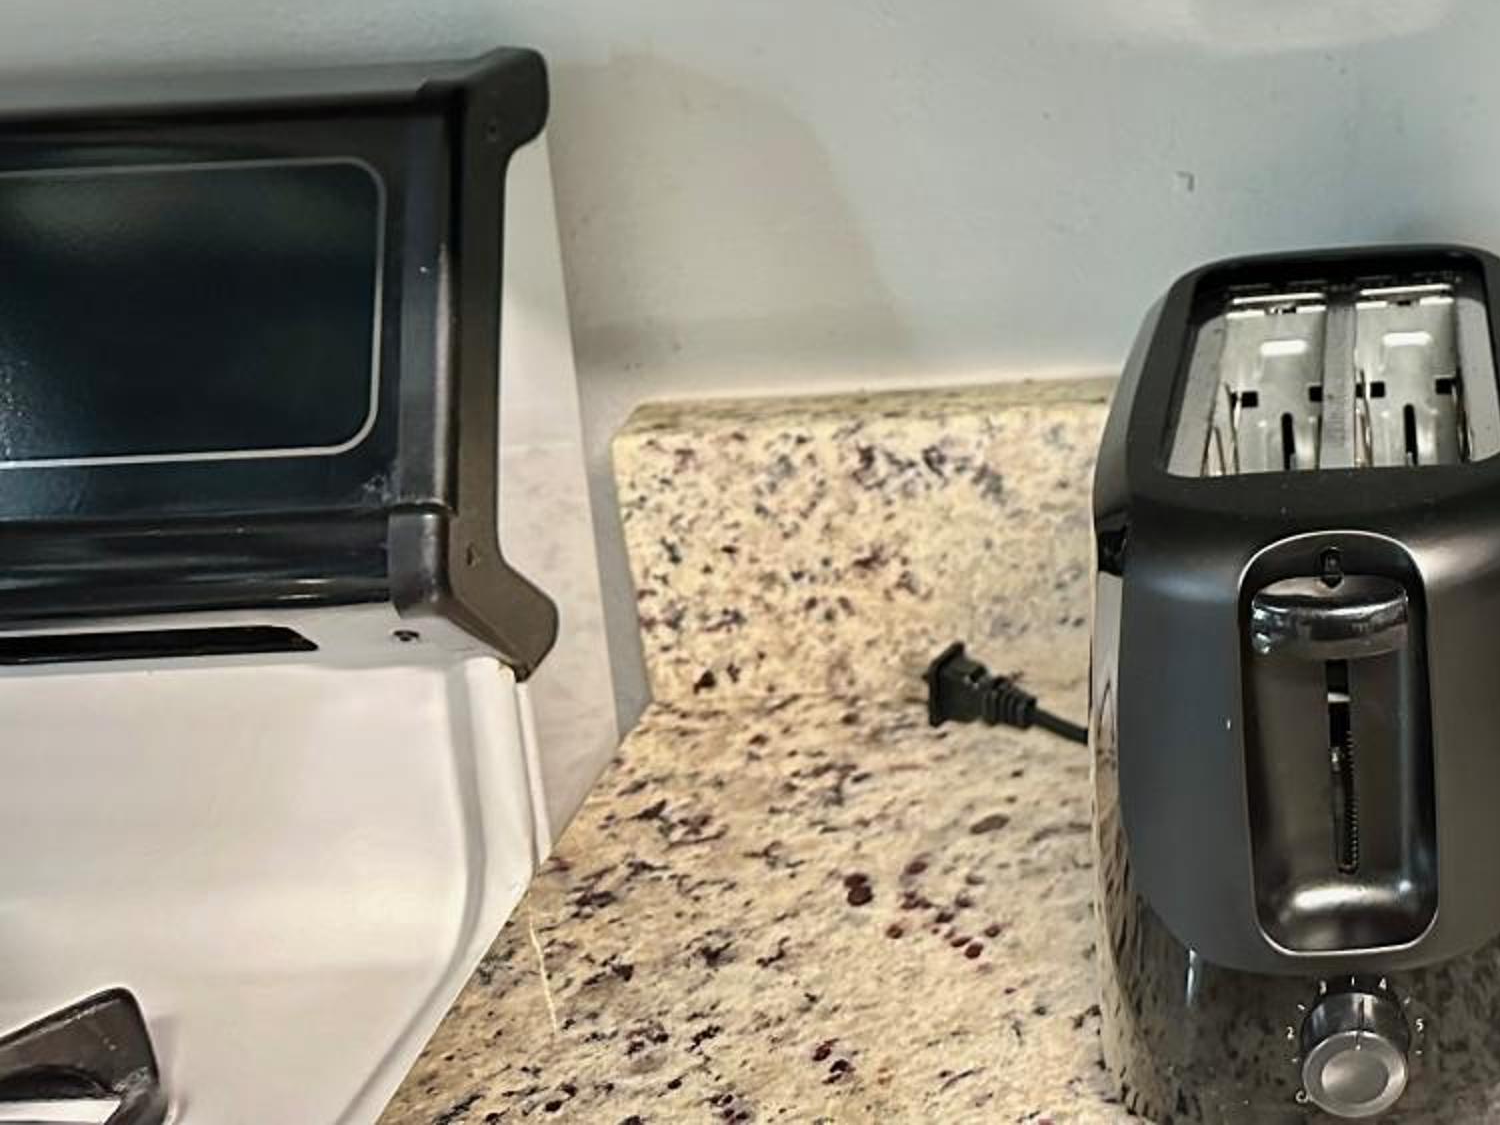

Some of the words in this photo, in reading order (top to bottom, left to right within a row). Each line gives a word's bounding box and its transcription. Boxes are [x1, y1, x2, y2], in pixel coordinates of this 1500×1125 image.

[1319, 980, 1327, 995] 3
[1379, 977, 1387, 991] 4
[1415, 1018, 1424, 1033] 5
[1286, 1026, 1294, 1041] 2
